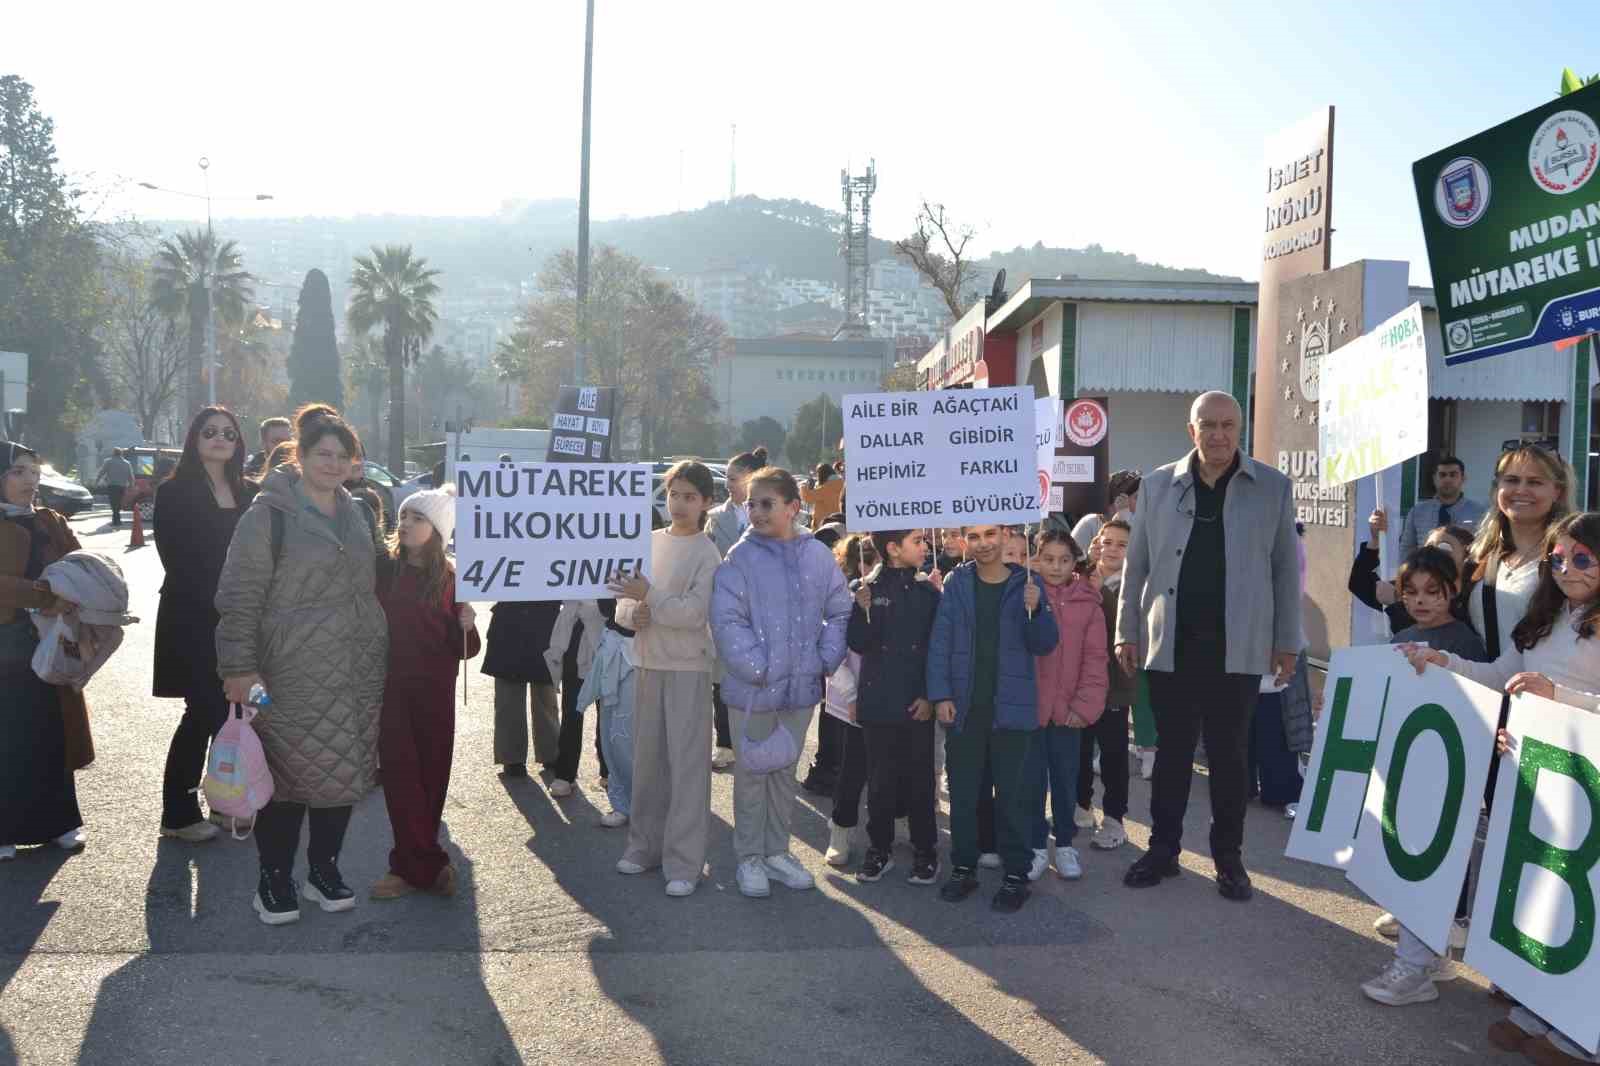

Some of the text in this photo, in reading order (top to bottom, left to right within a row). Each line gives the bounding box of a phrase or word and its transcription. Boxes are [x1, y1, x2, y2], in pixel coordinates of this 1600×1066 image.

[1450, 231, 1600, 309] MÜTAREKE İ
[1578, 305, 1600, 321] BUR
[851, 393, 1019, 419] AİLE BİR AĞAÇTAKİ
[860, 425, 1015, 449] DALLAR GİBİDİR
[857, 459, 1018, 481] HEPİMİZ FARKLI
[1278, 450, 1319, 477] BUR
[458, 463, 647, 498] MÜTAREKE
[855, 500, 943, 518] YÖNLERDE
[952, 495, 1041, 514] BÜYÜRÜZ.
[1295, 502, 1347, 527] EDİYESİ
[474, 505, 642, 540] İLKOKULU
[462, 557, 525, 593] 4/E
